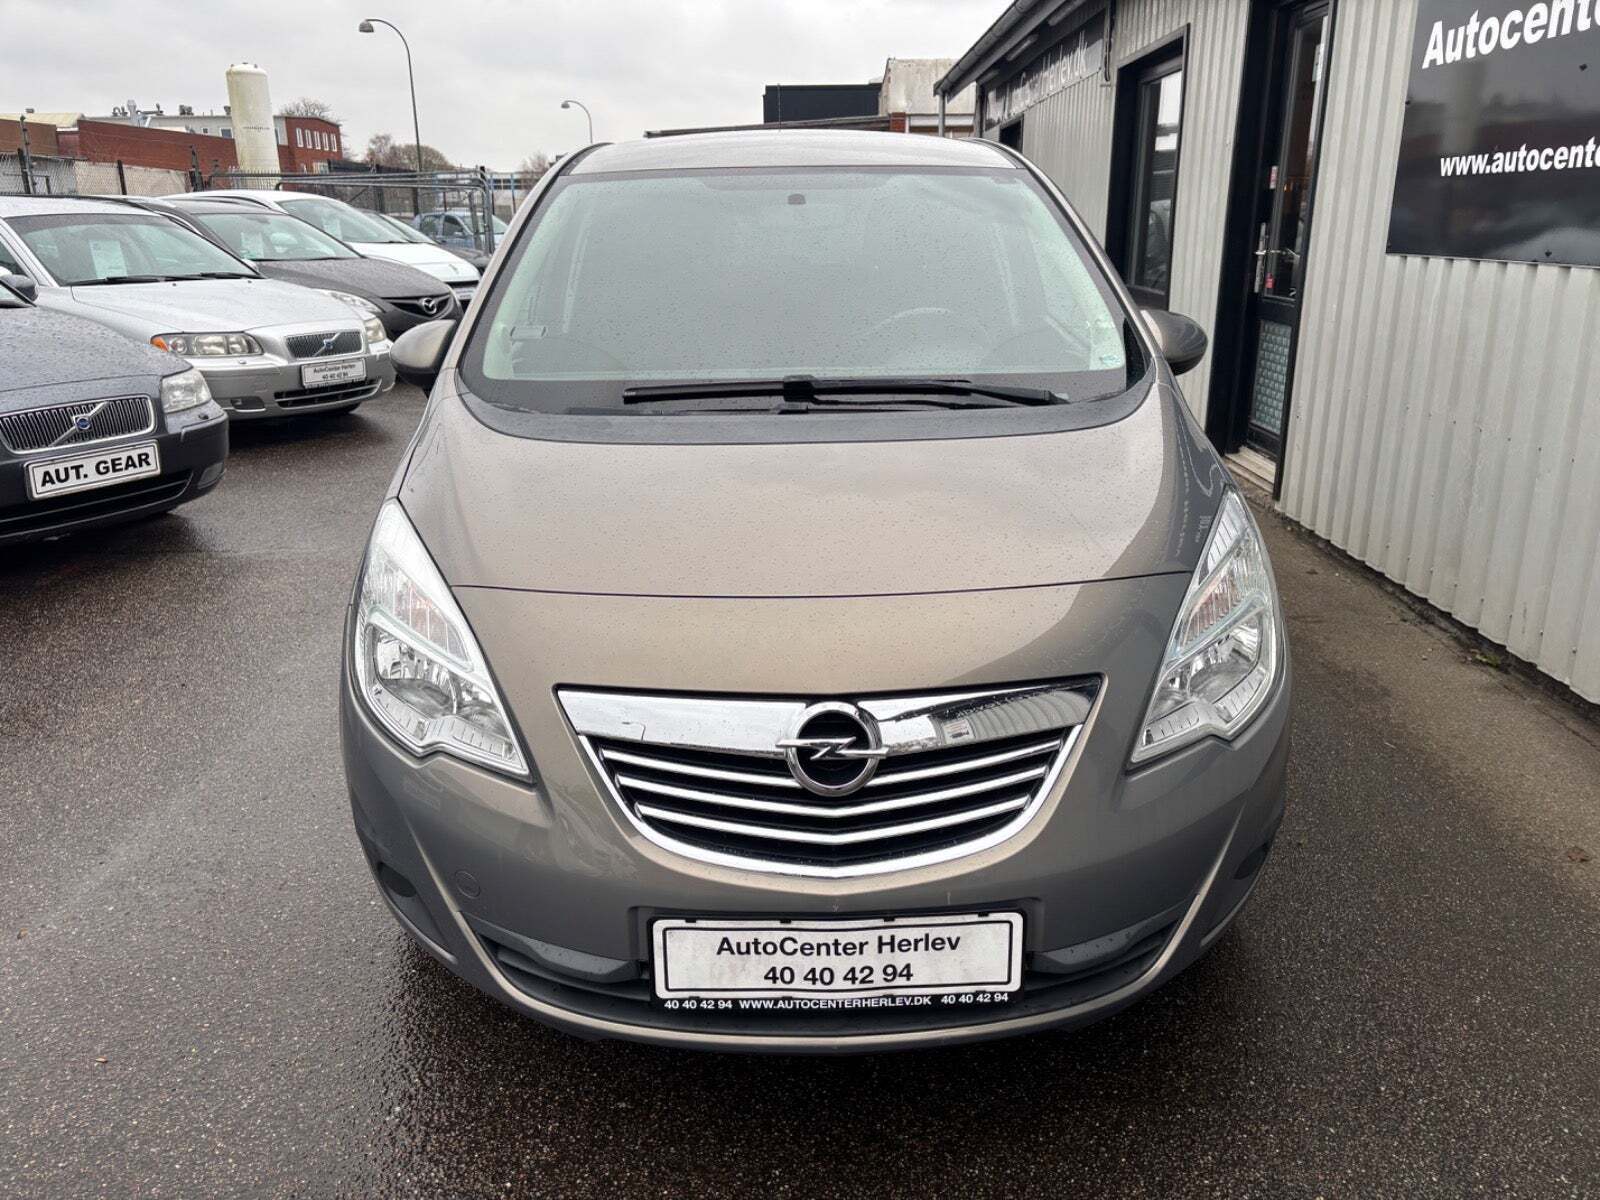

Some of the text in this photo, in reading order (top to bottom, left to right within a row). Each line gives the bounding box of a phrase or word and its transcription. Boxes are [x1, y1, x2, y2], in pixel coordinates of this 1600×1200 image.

[41, 452, 151, 487] AUT. GEAR
[716, 933, 961, 957] AutoCenter Herlev
[763, 963, 913, 986] 40 40 42 94
[664, 992, 1009, 1010] 40 40 42 94 WWW.AUTOCENTERHERLEV.DK 40 40 42 94
